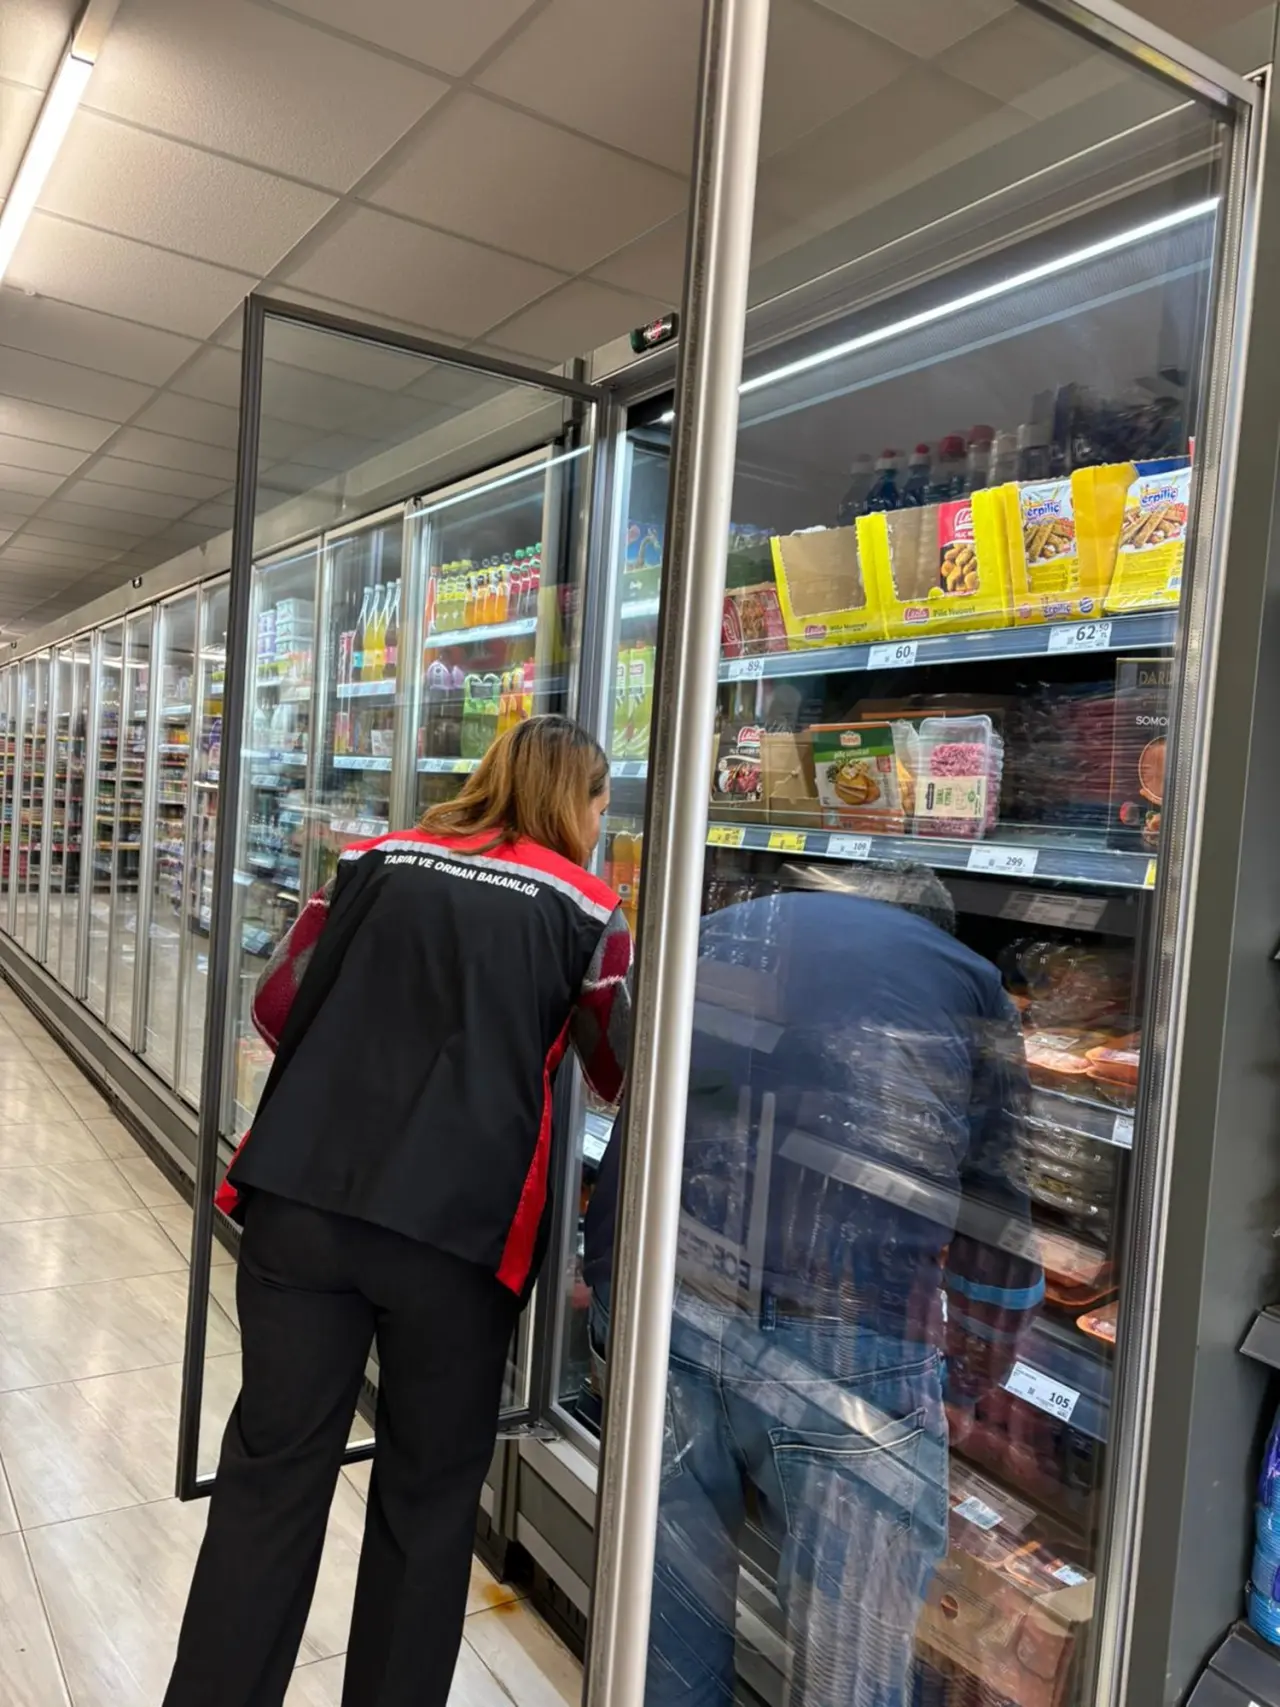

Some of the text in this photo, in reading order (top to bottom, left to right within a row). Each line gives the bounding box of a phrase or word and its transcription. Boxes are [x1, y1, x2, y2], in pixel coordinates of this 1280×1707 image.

[896, 645, 911, 659] 60
[1136, 716, 1169, 726] SOMO
[1006, 856, 1023, 867] 299
[384, 854, 540, 898] TARIM VE ORMAN BAKANLIĞI
[1049, 1392, 1070, 1408] 105
